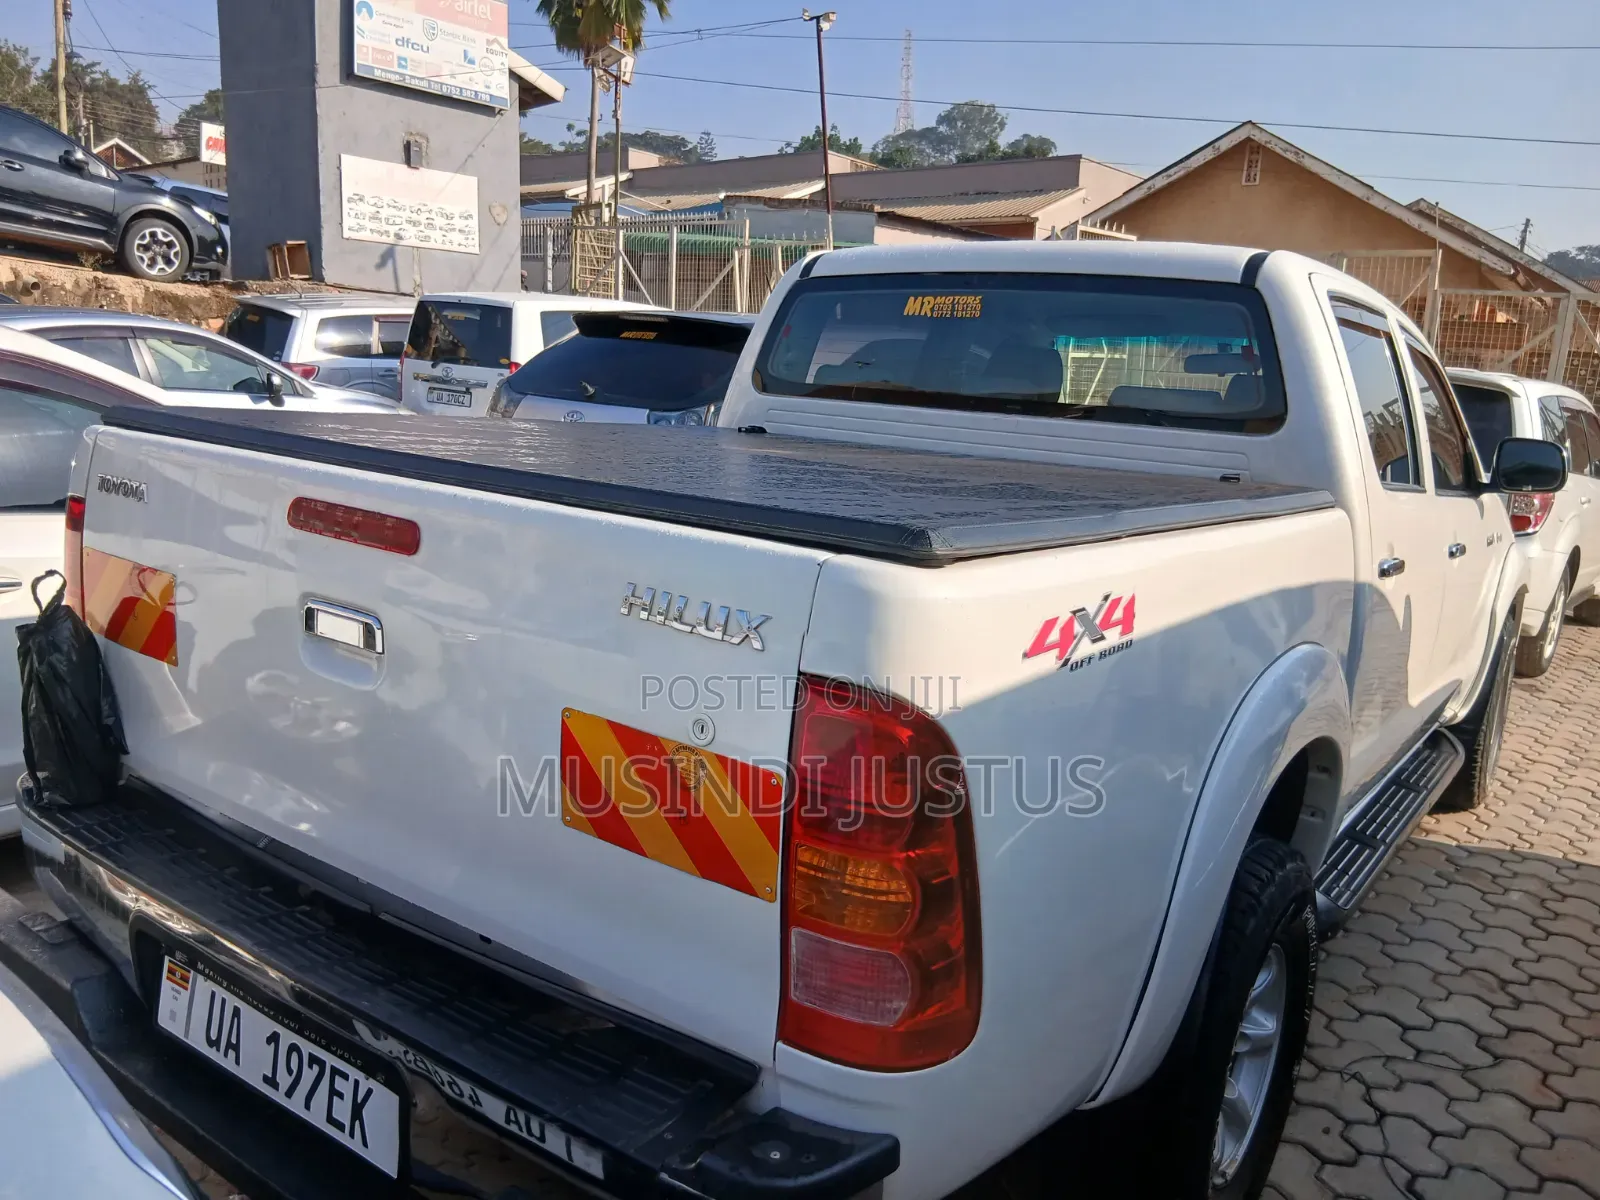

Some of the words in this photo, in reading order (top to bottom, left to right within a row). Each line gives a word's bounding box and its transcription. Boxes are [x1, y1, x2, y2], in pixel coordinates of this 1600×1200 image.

[454, 0, 492, 21] airtel
[395, 36, 430, 54] dfcu
[485, 47, 509, 59] EQUITY
[442, 85, 460, 95] 0752
[903, 296, 935, 317] MR
[934, 296, 983, 304] MOTORS
[933, 310, 951, 318] 0772
[97, 473, 149, 504] TOYOTA
[620, 582, 773, 651] HILUX
[1068, 654, 1096, 673] OFF
[1098, 639, 1134, 661] ROAD
[204, 988, 241, 1067] UA
[262, 1030, 375, 1150] 197EK
